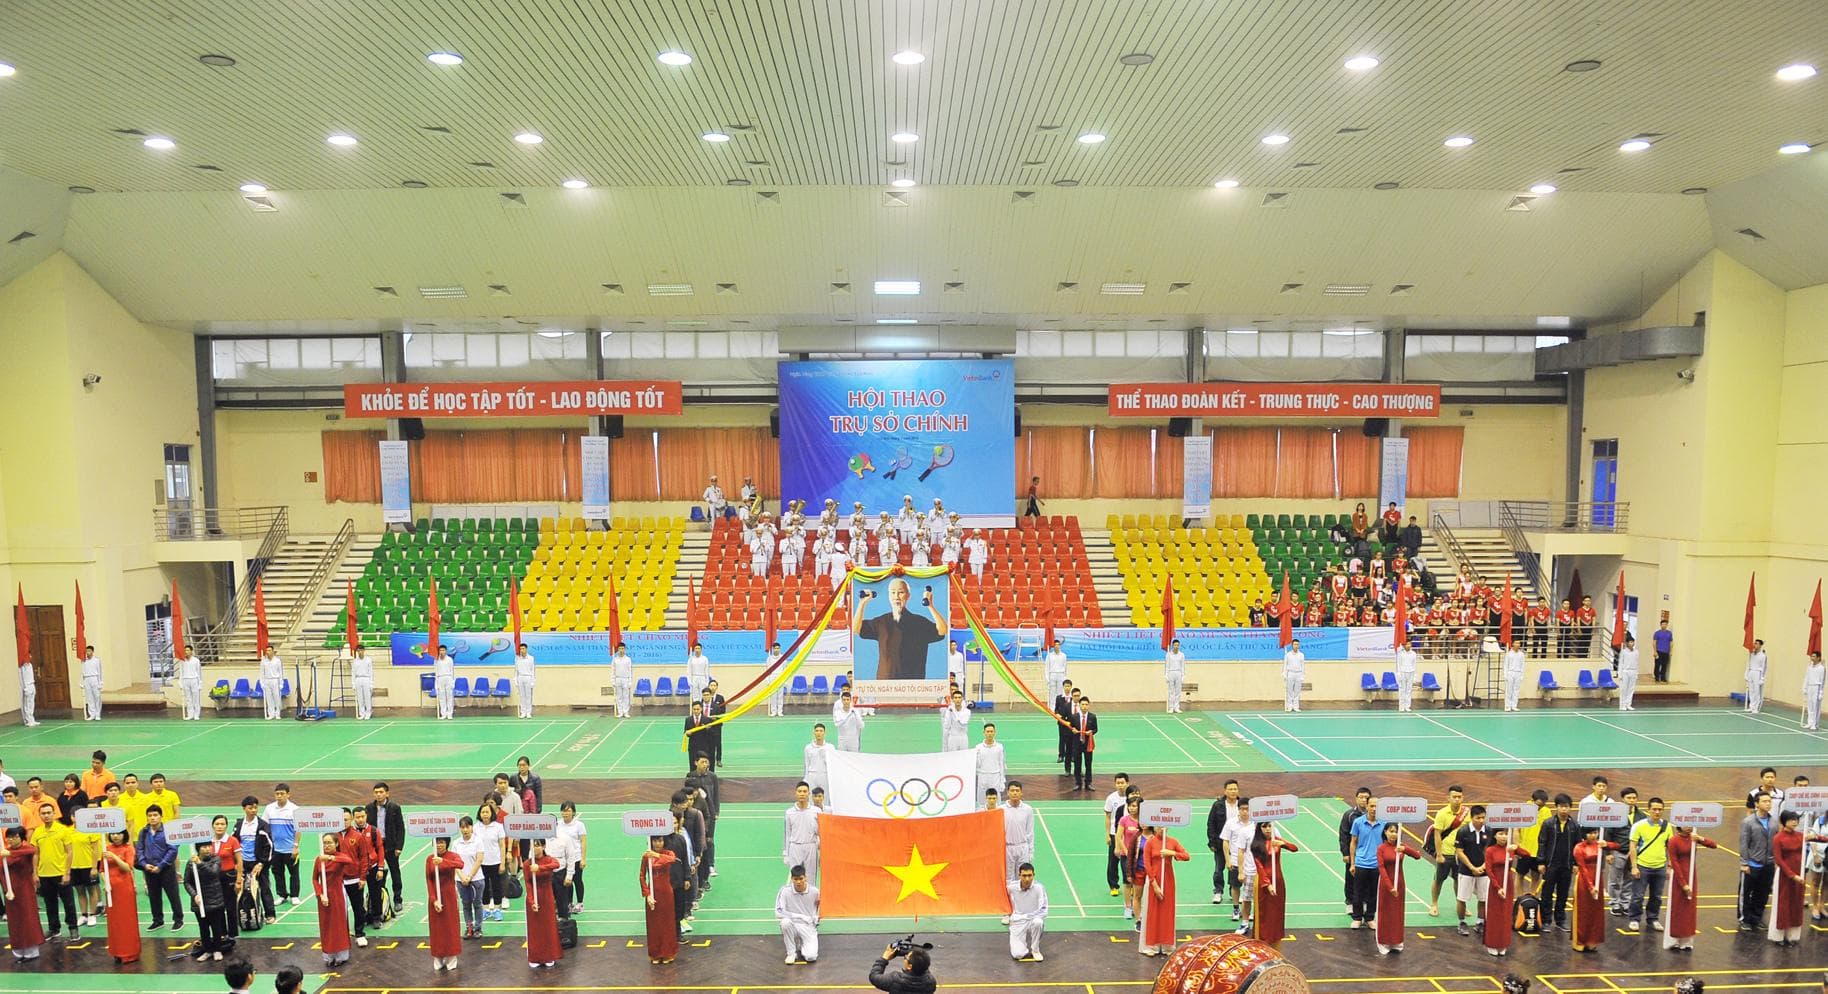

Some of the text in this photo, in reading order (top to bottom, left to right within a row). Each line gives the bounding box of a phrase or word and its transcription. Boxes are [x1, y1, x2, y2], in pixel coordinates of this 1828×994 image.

[361, 387, 403, 411] KHỎE
[408, 386, 429, 410] ĐỂ
[434, 392, 466, 413] HỌC
[471, 388, 502, 413] TẬP
[506, 386, 535, 410] TỐT
[551, 391, 581, 409] LAO
[586, 387, 631, 412] ĐỘNG
[635, 384, 665, 409] TỐT
[848, 387, 946, 411] HỘI THAO
[1116, 388, 1141, 409] THỂ
[1144, 393, 1178, 409] THAO
[1181, 389, 1219, 409] ĐOÀN
[1222, 389, 1246, 409] KẾT
[1259, 393, 1302, 409] TRUNG
[1306, 393, 1339, 412] THỰC
[1353, 394, 1378, 409] CAO
[1381, 393, 1433, 413] THƯỢNG
[830, 411, 968, 435] TRỤ SỞ CHÍNH
[630, 819, 653, 830] TRỌNG
